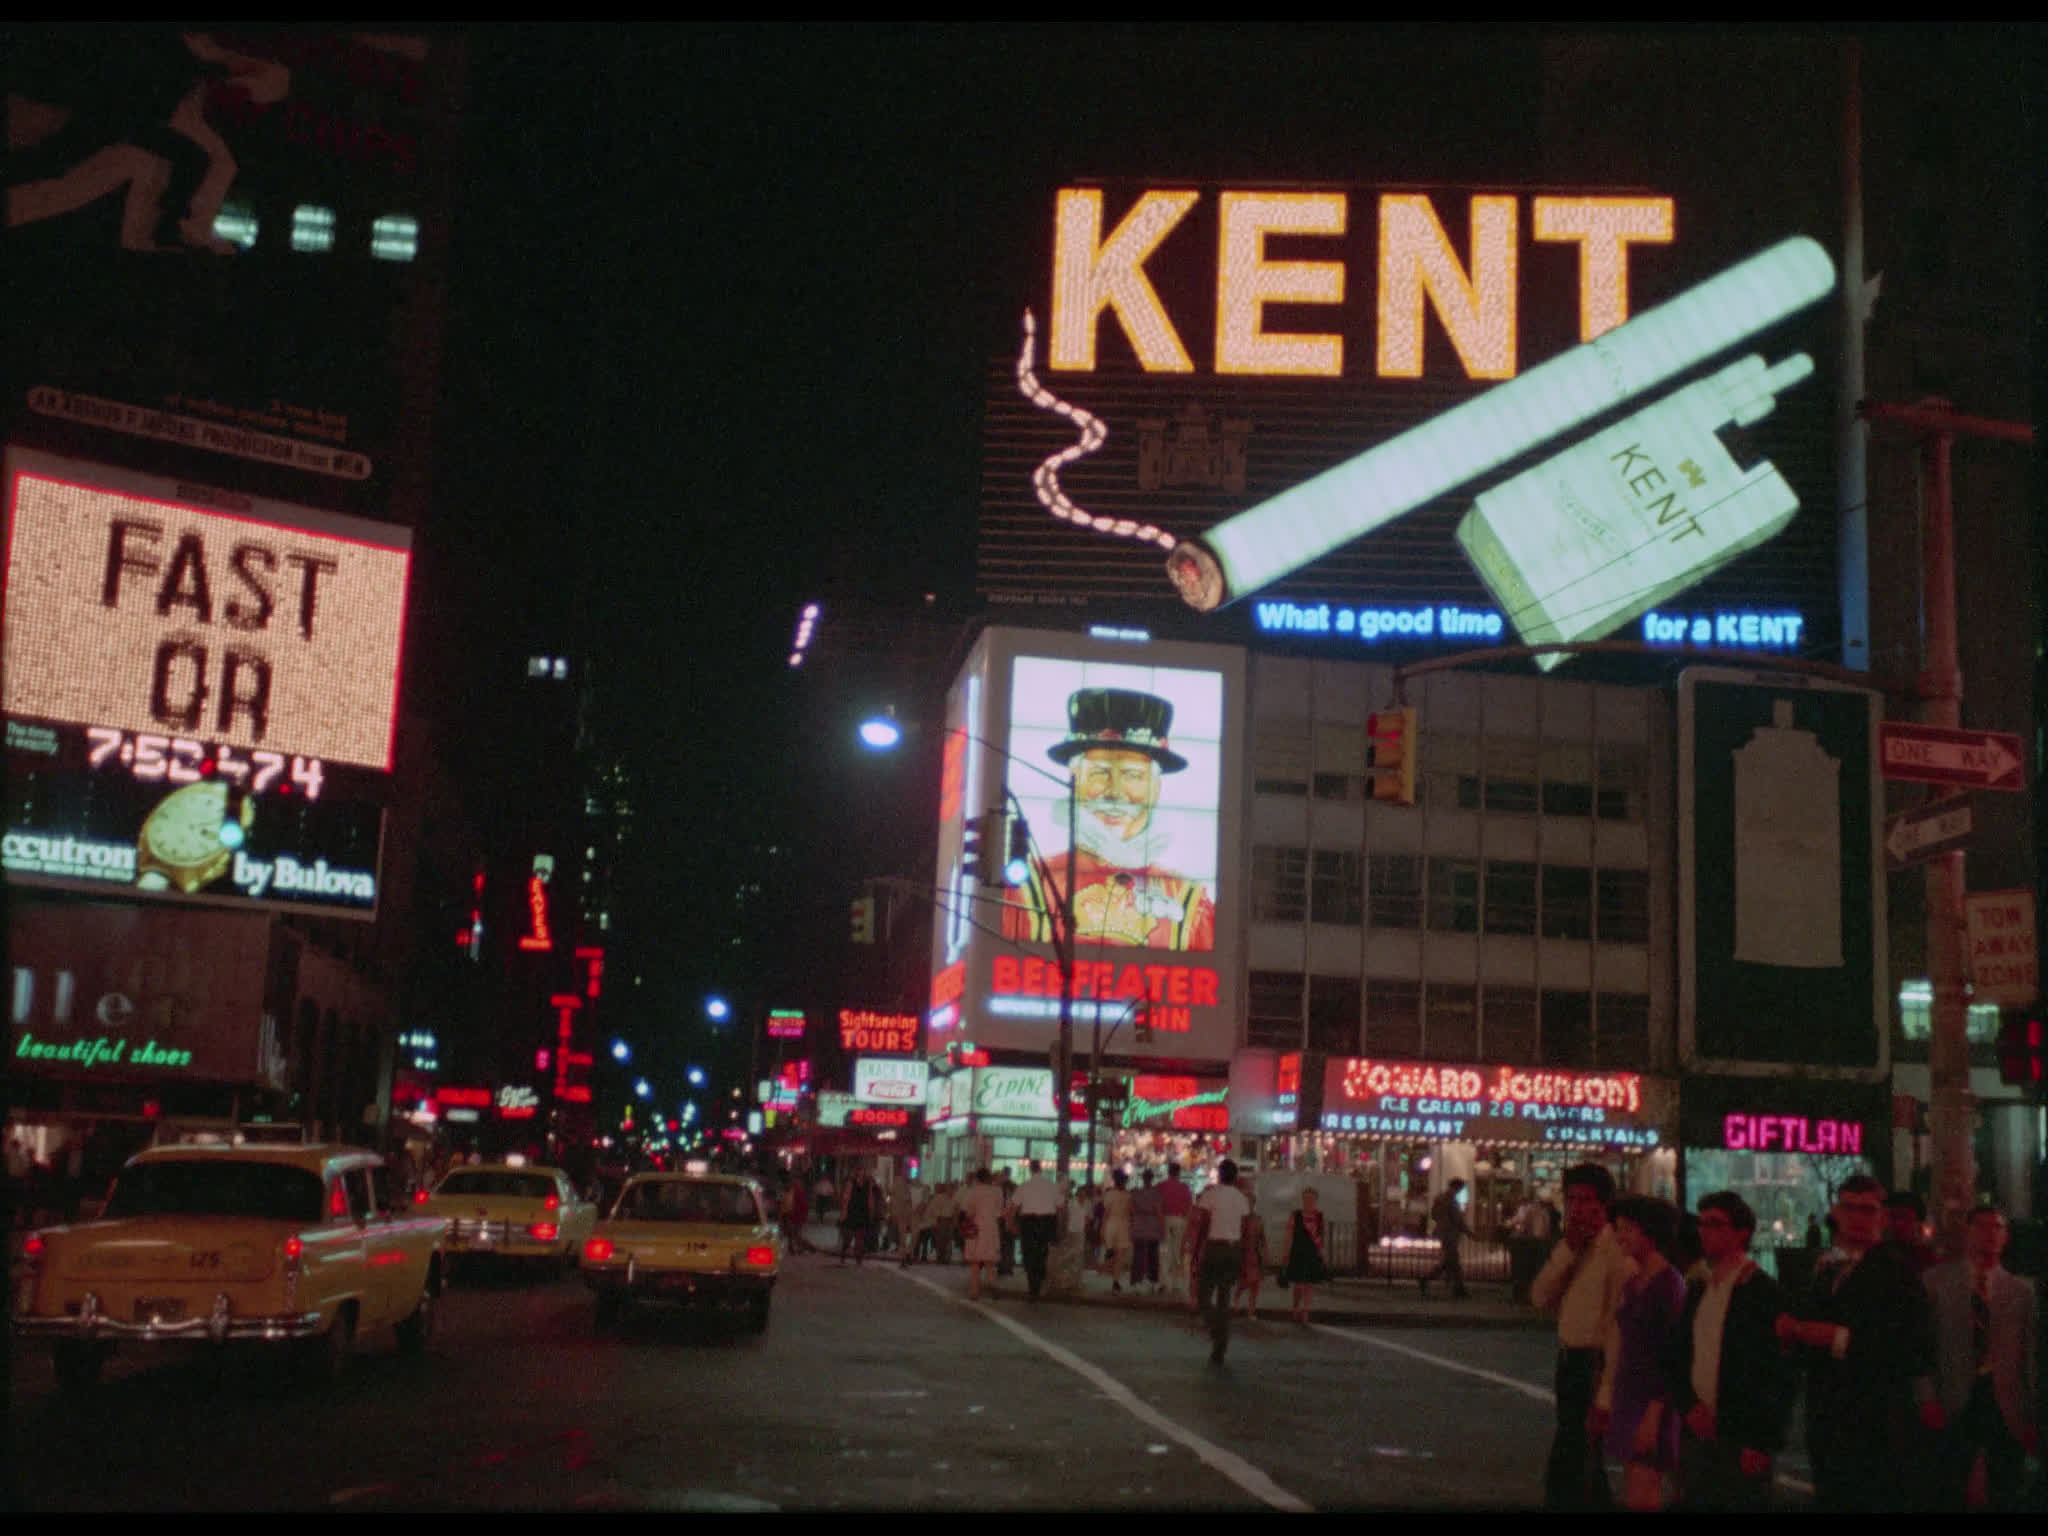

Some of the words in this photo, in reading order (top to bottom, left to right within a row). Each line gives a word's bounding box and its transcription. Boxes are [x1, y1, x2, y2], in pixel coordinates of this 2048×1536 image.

[1049, 187, 1677, 381] KENT
[1609, 443, 1706, 544] KENT
[102, 514, 339, 642] FAST
[1257, 602, 1330, 632] What
[1335, 610, 1354, 632] a
[1360, 606, 1435, 639] good
[1440, 606, 1503, 637] time
[1644, 613, 1688, 640] for
[1692, 620, 1712, 642] a
[1717, 615, 1802, 645] KENT
[149, 632, 274, 745] OR
[233, 852, 271, 897] by
[273, 856, 376, 900] Bulova
[1977, 906, 2022, 928] TOW
[1974, 935, 2034, 955] AWAY
[992, 955, 1219, 1006] BEEFEATER
[1978, 960, 2036, 988] ZONE
[16, 1033, 127, 1069] beautiful
[129, 1039, 192, 1067] shoes
[842, 1030, 916, 1051] TOURS
[852, 1108, 910, 1126] BOOKS
[1325, 1112, 1466, 1135] RESTAURANT
[1544, 1125, 1661, 1147] COCKTAILS
[1724, 1111, 1864, 1156] GIFTLAN
